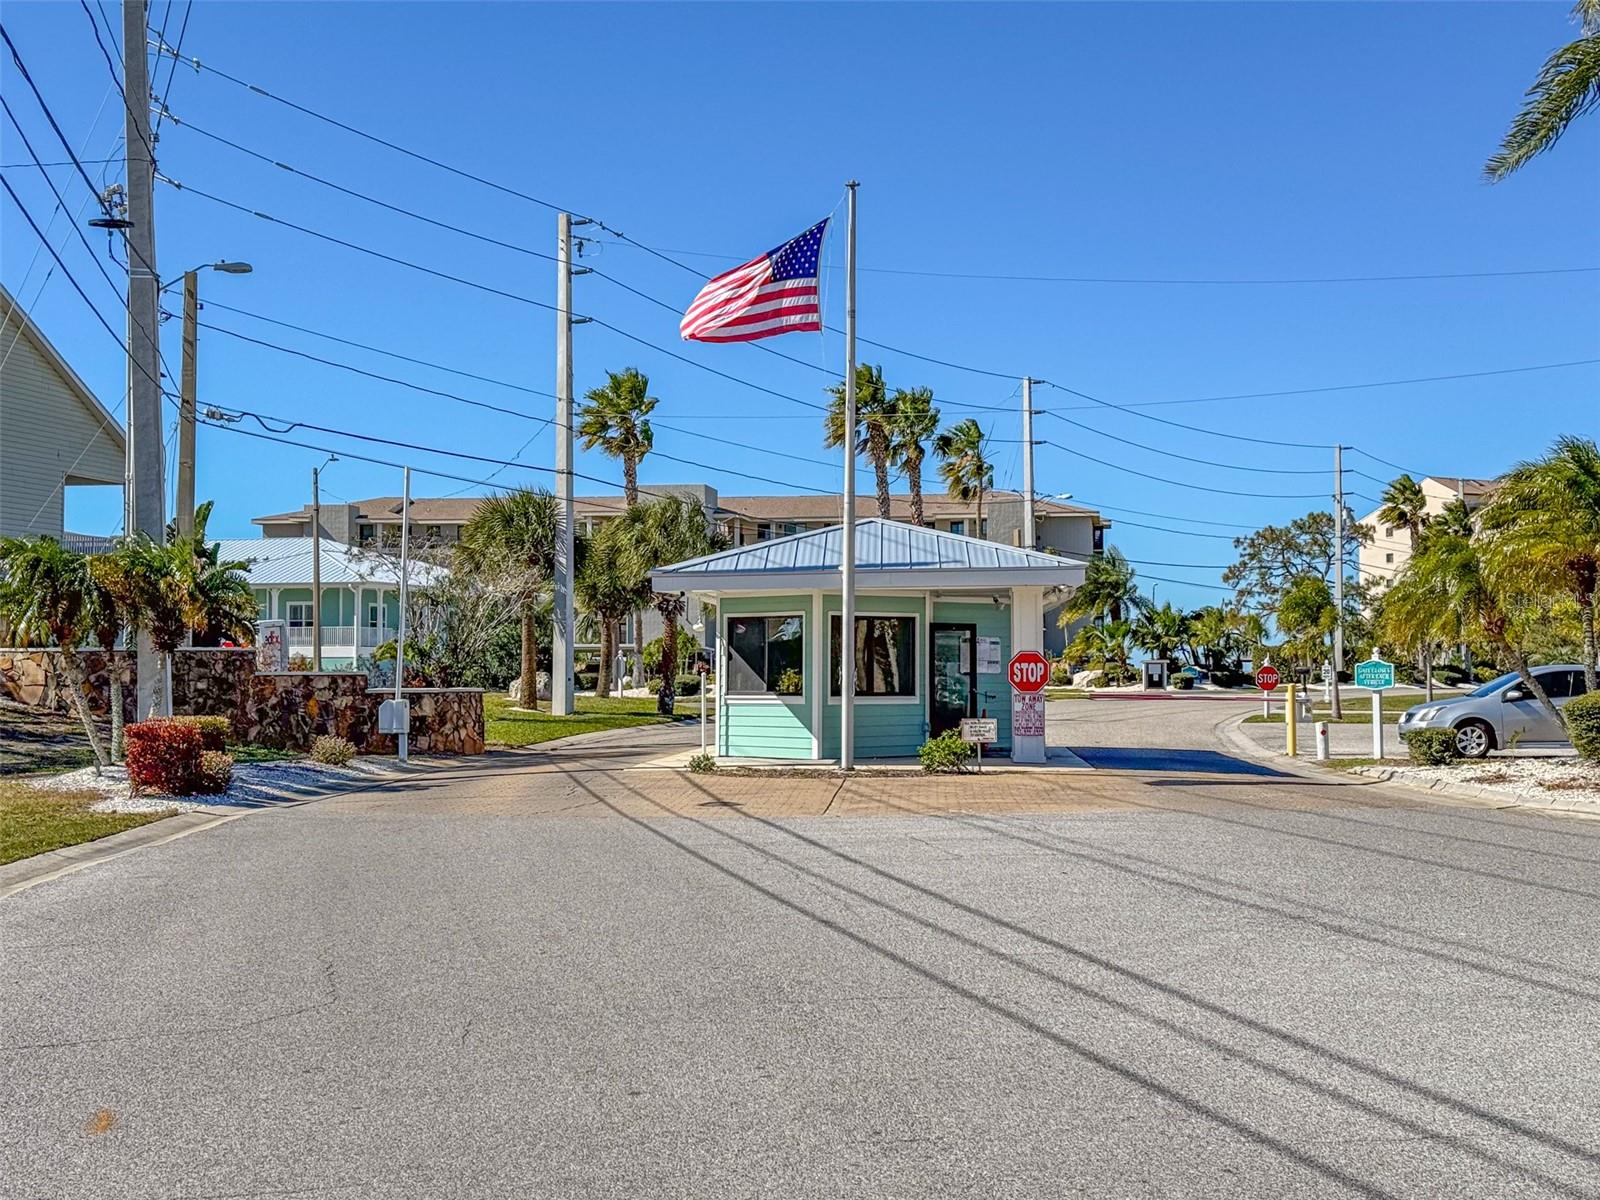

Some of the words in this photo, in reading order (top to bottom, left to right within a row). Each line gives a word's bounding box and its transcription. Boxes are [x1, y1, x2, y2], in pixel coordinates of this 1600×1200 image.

[1013, 662, 1045, 683] STOP
[1258, 673, 1278, 684] STOP
[1014, 694, 1026, 703] TOW
[1028, 694, 1043, 703] AWAY
[1021, 702, 1036, 711] ZONE
